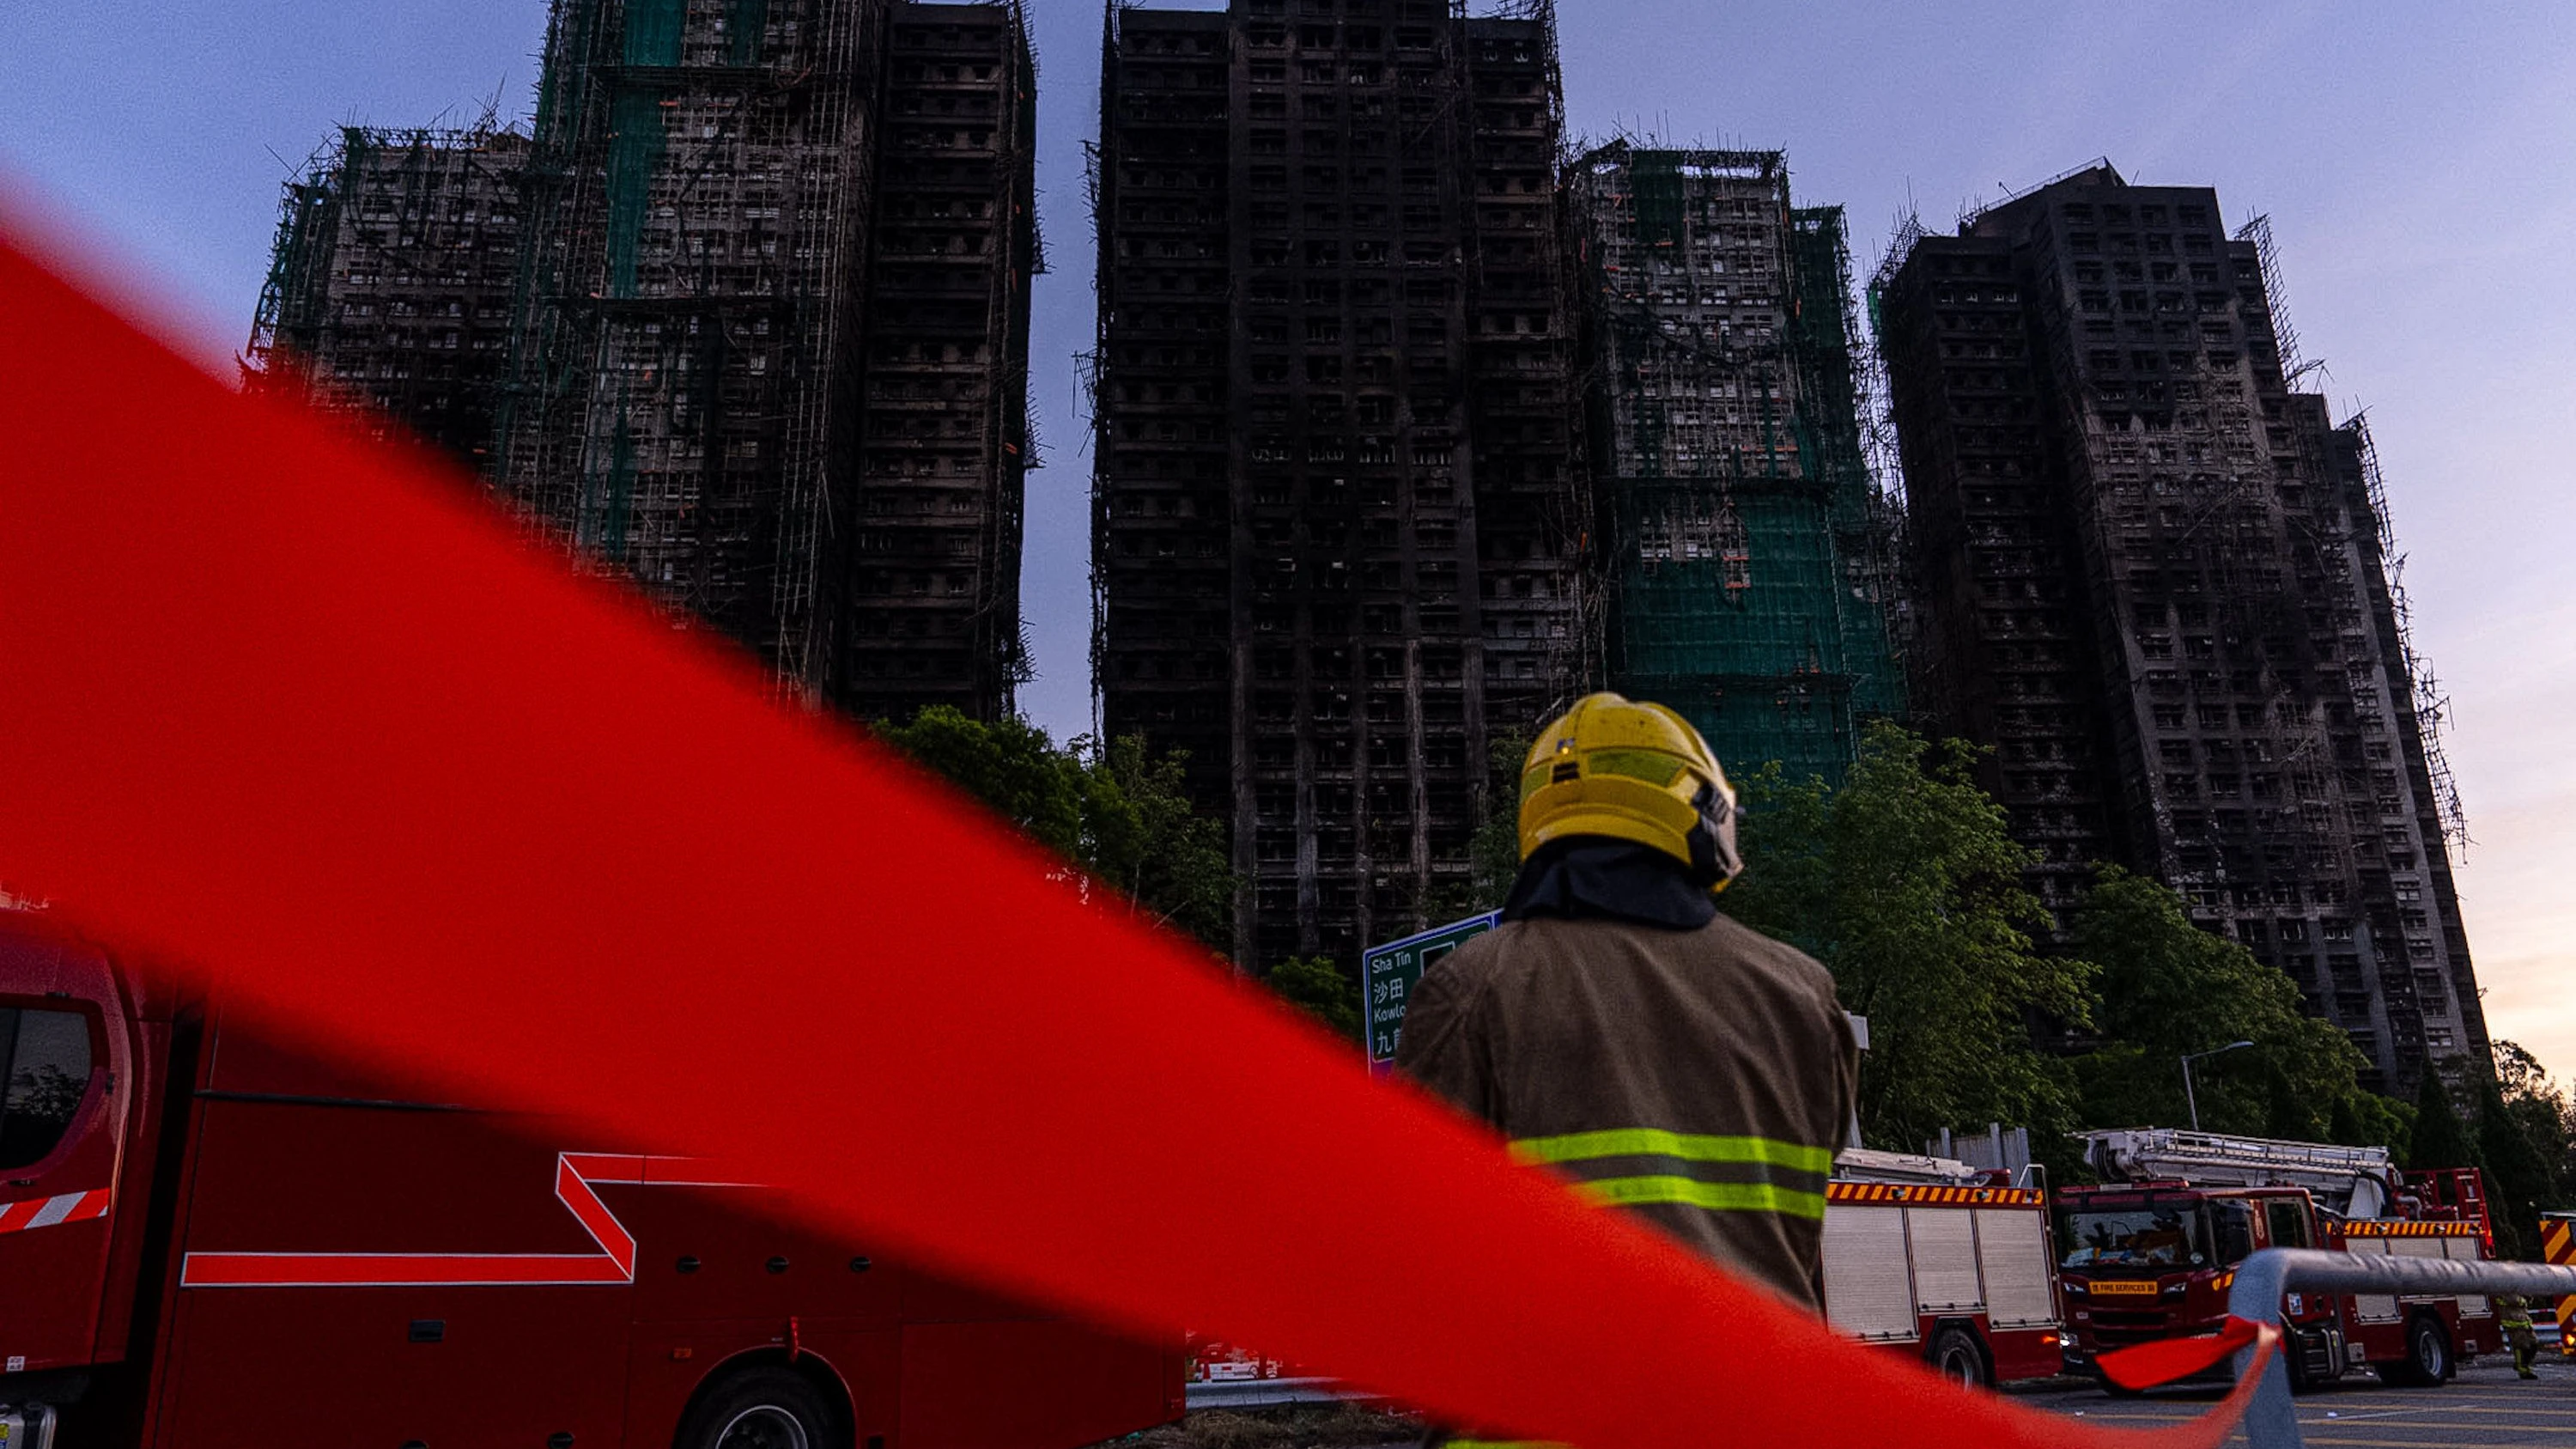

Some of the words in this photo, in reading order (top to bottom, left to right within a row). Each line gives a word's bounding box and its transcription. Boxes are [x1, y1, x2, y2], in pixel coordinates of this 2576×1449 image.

[1371, 958, 1393, 974] Sha
[1394, 951, 1412, 967] Tin
[1374, 977, 1403, 1004] 沙田
[1374, 1003, 1406, 1024] Kowlo
